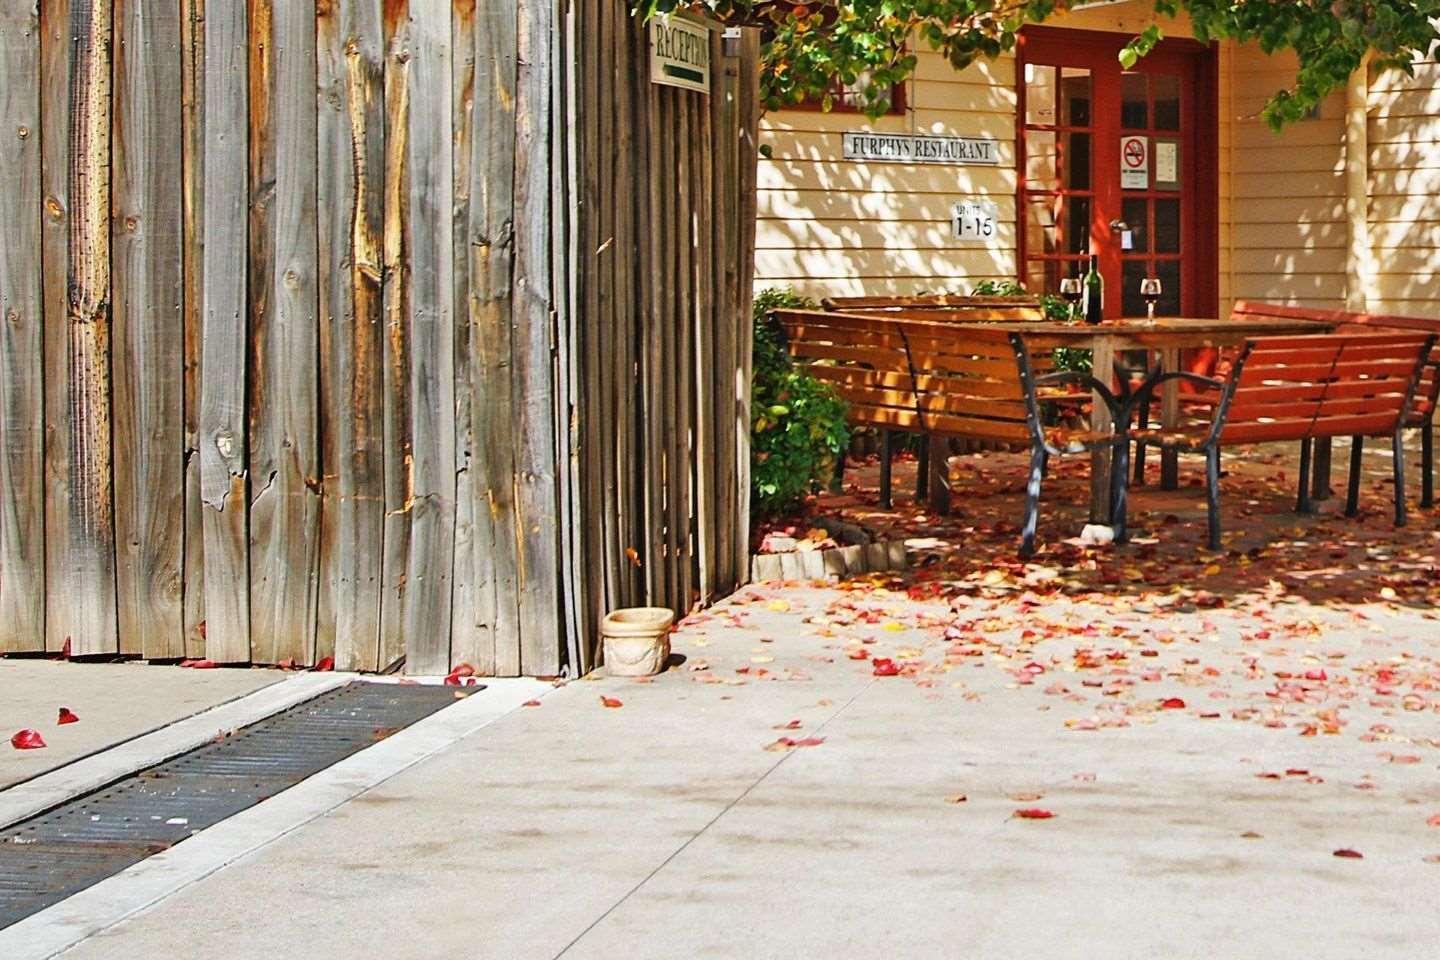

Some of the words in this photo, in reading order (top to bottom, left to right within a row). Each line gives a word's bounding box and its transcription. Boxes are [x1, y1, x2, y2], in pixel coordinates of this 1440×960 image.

[852, 136, 910, 156] FURPHYS
[915, 139, 991, 160] RESTAURANT
[956, 217, 992, 236] 1-15
